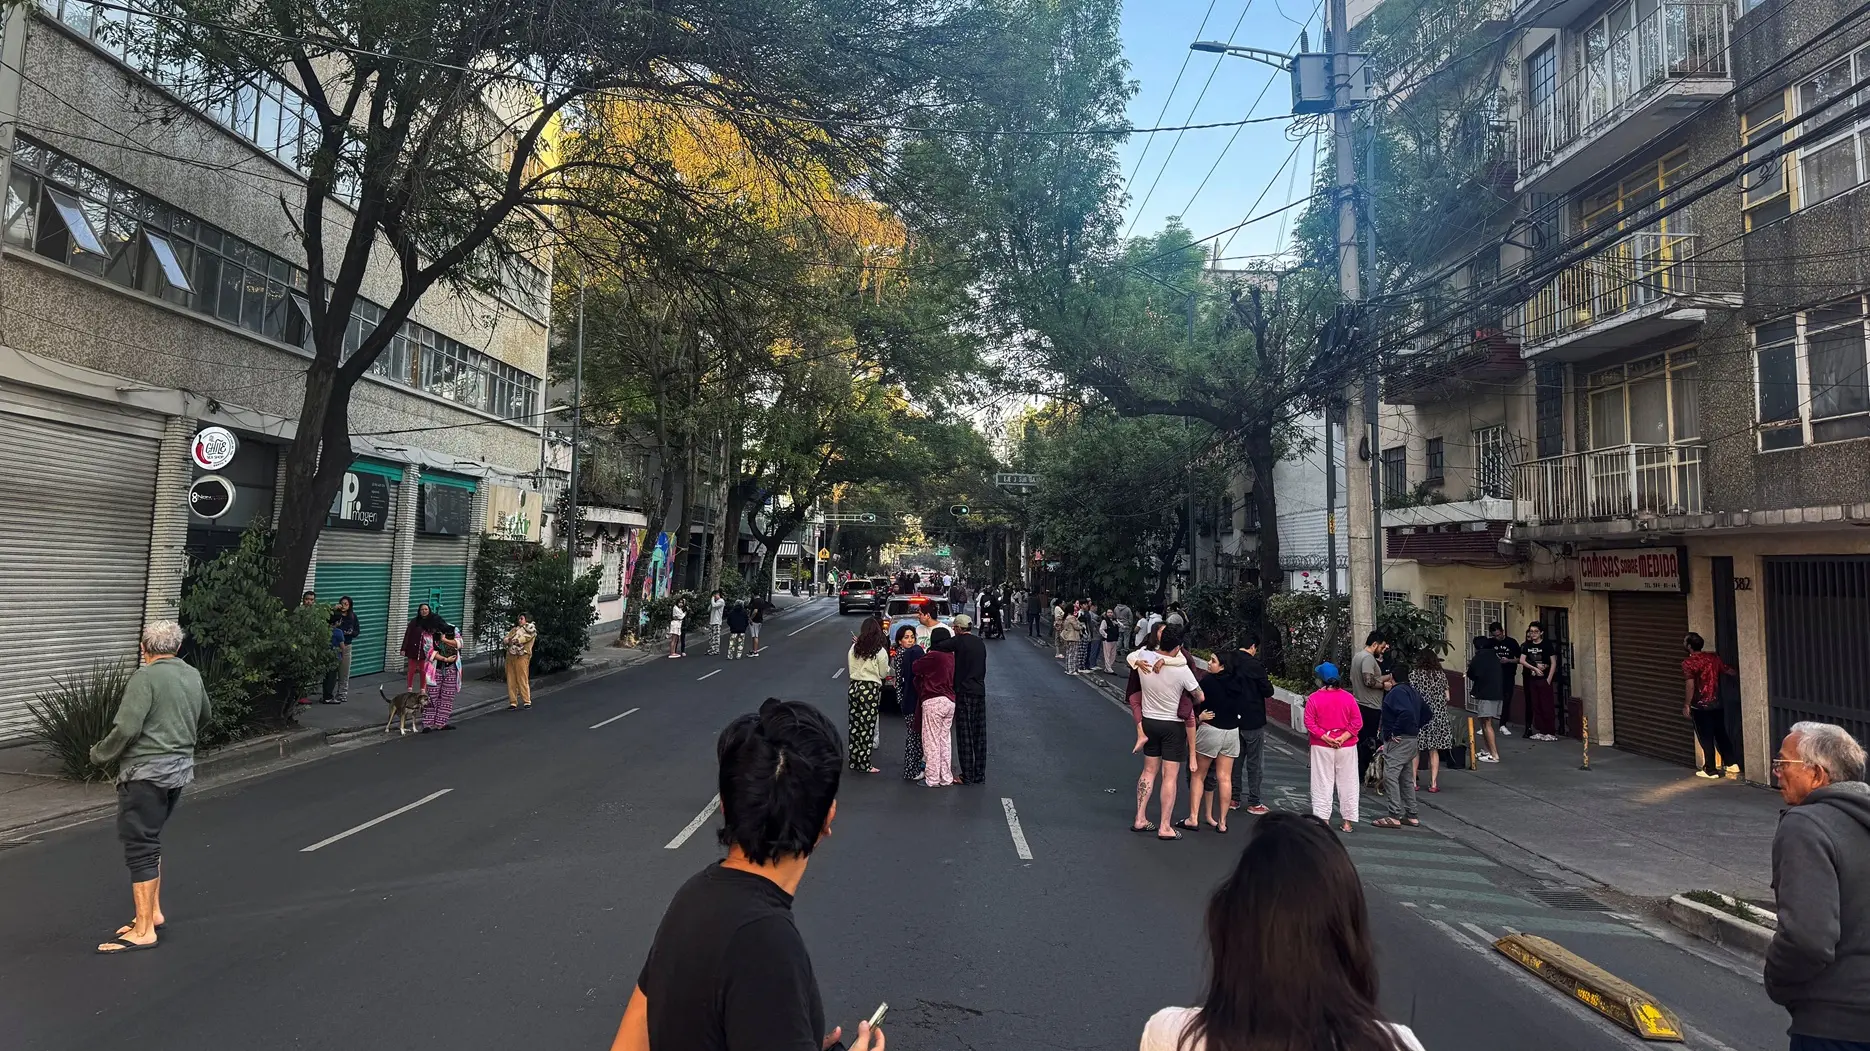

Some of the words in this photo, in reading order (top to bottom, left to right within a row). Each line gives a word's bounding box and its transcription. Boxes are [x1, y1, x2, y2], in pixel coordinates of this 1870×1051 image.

[1581, 553, 1620, 578] CAMISAS
[1620, 558, 1638, 574] SOBRE
[1638, 554, 1677, 578] MEDIDA
